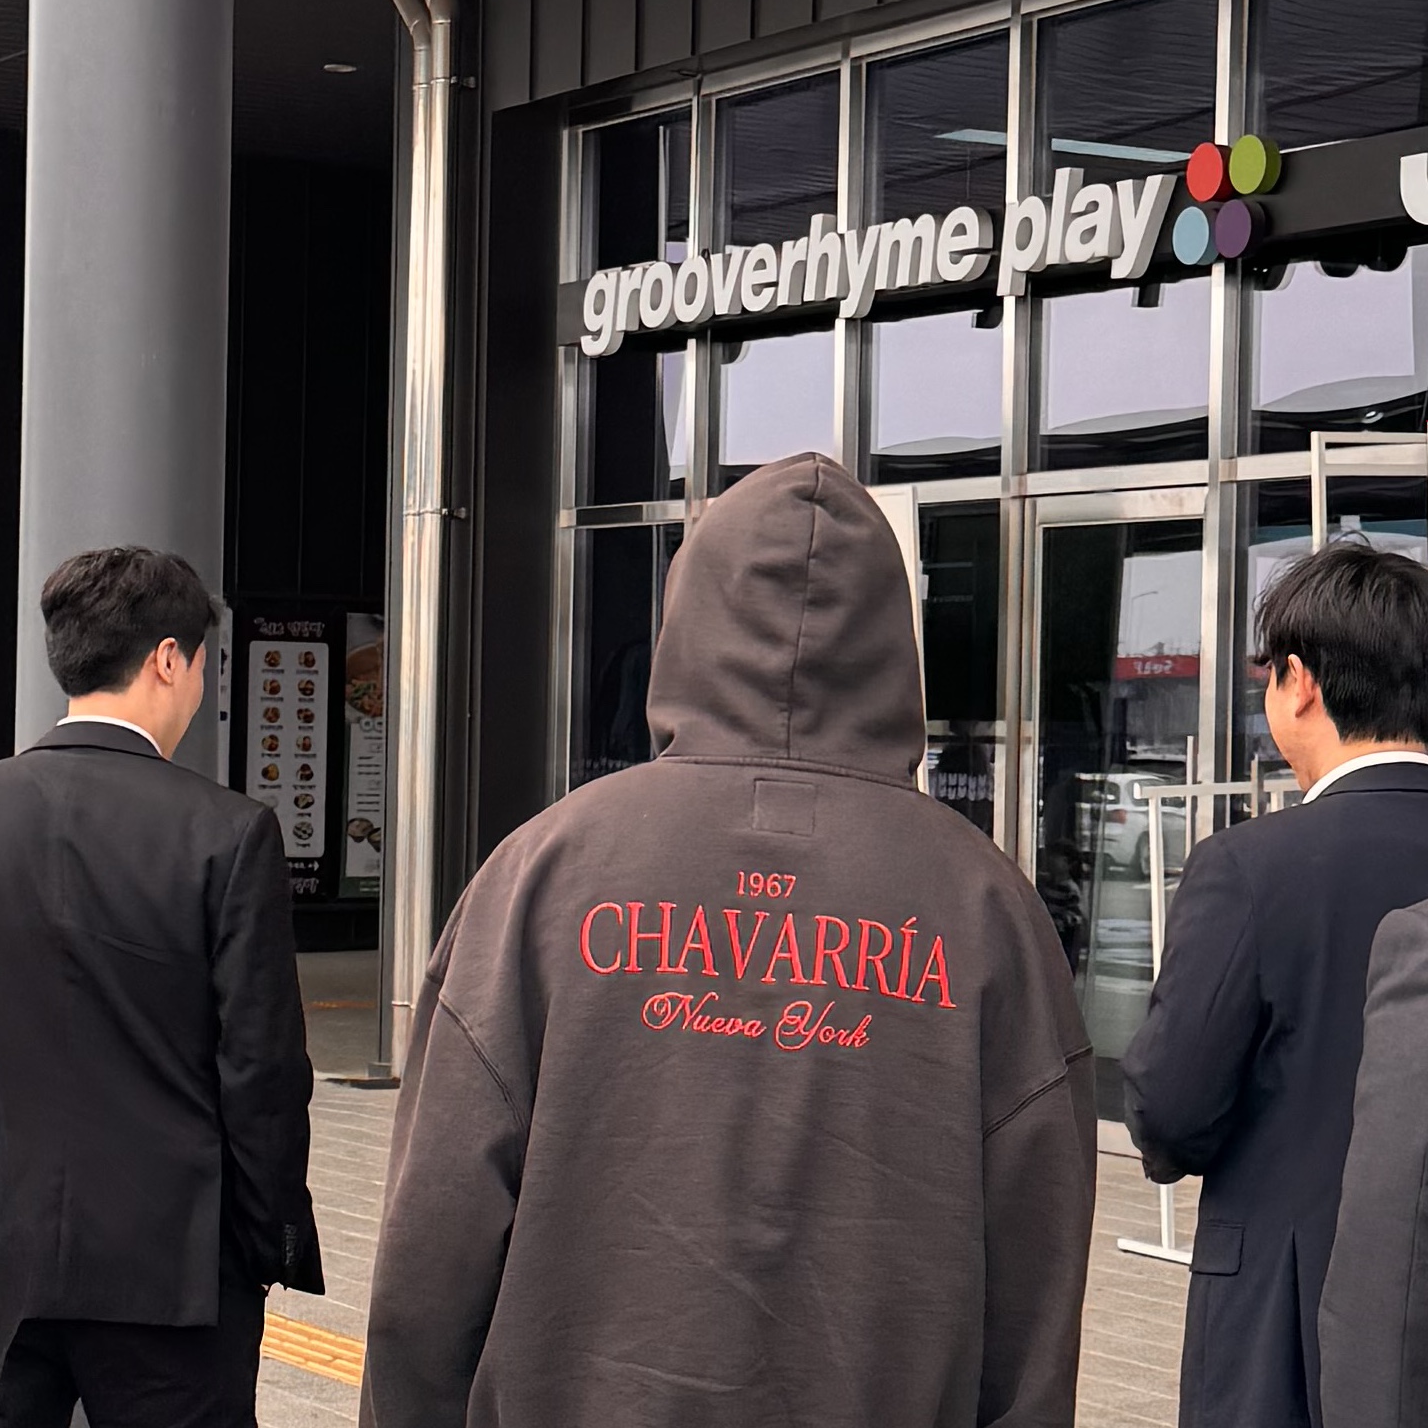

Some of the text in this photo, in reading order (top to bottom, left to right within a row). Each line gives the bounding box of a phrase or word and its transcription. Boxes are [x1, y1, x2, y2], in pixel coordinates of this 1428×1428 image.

[580, 166, 1178, 357] grooverhyme play
[737, 870, 797, 899] 1967
[579, 901, 957, 1009] CHAVARRÍA
[641, 991, 871, 1051] Nueva York
